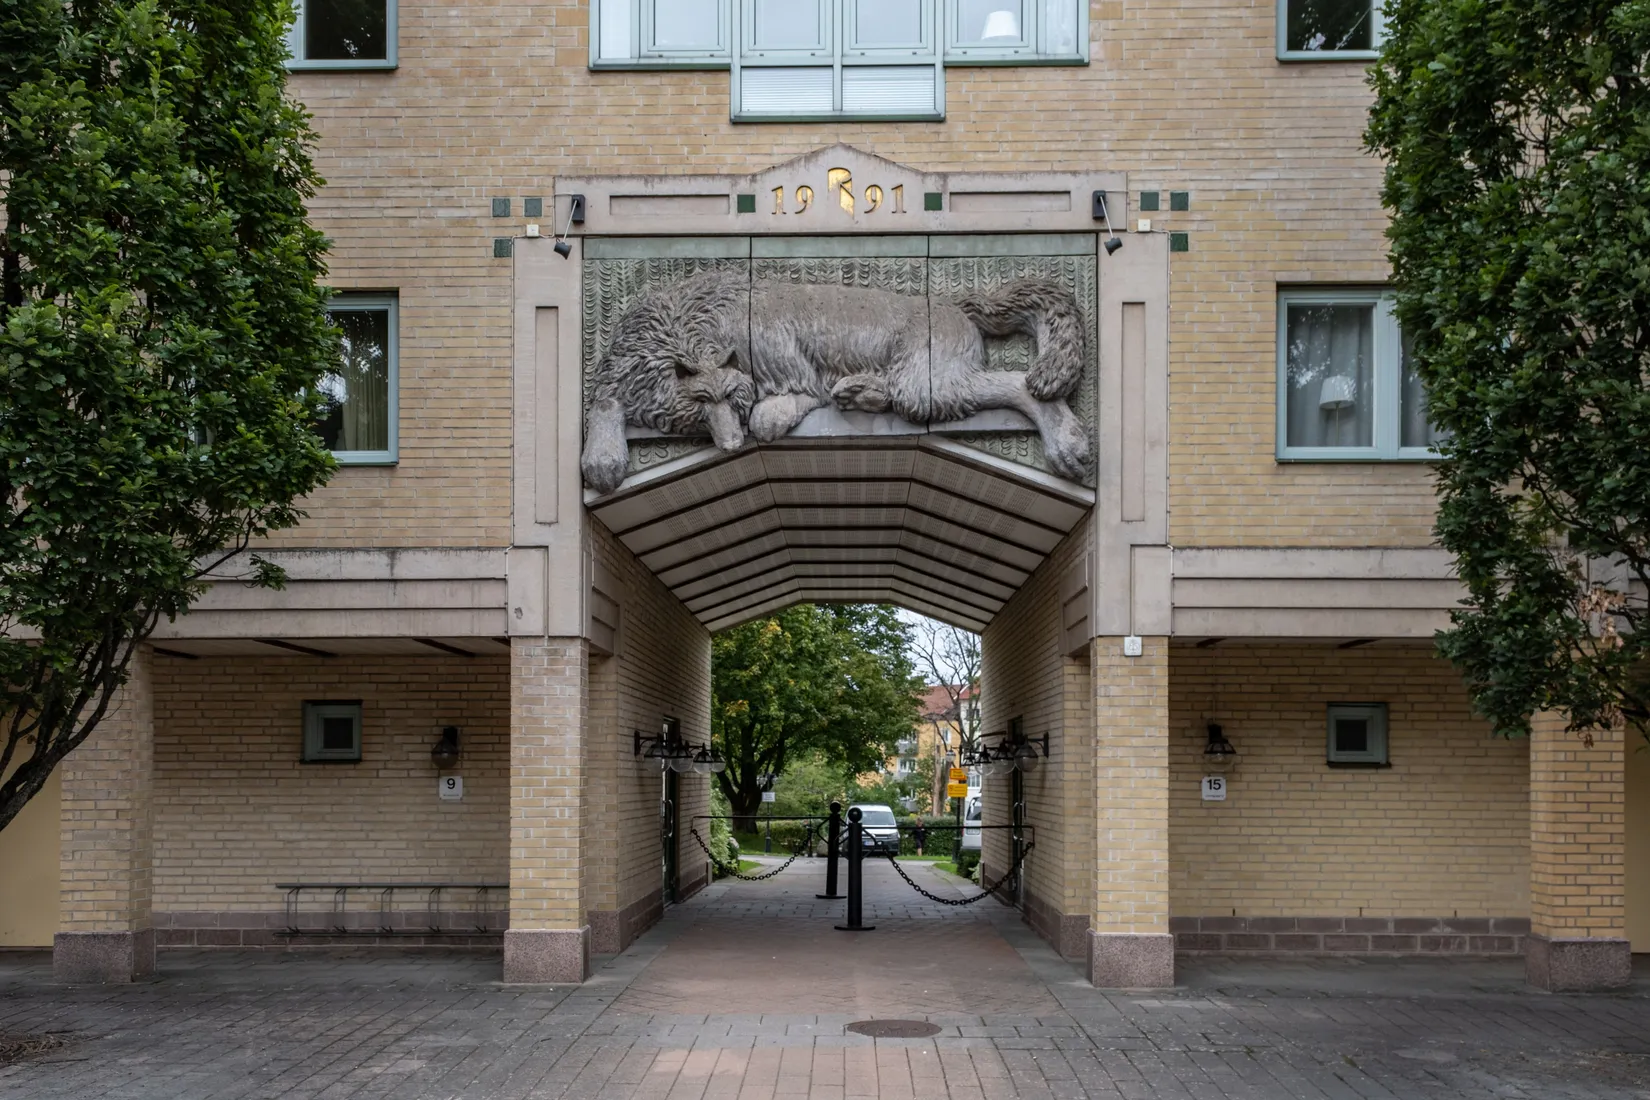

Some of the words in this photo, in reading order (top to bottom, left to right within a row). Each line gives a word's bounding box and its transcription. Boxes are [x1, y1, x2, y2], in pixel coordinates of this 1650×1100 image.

[771, 184, 815, 215] 19
[863, 184, 907, 214] 91
[446, 777, 456, 790] 9
[1207, 778, 1222, 791] 15
